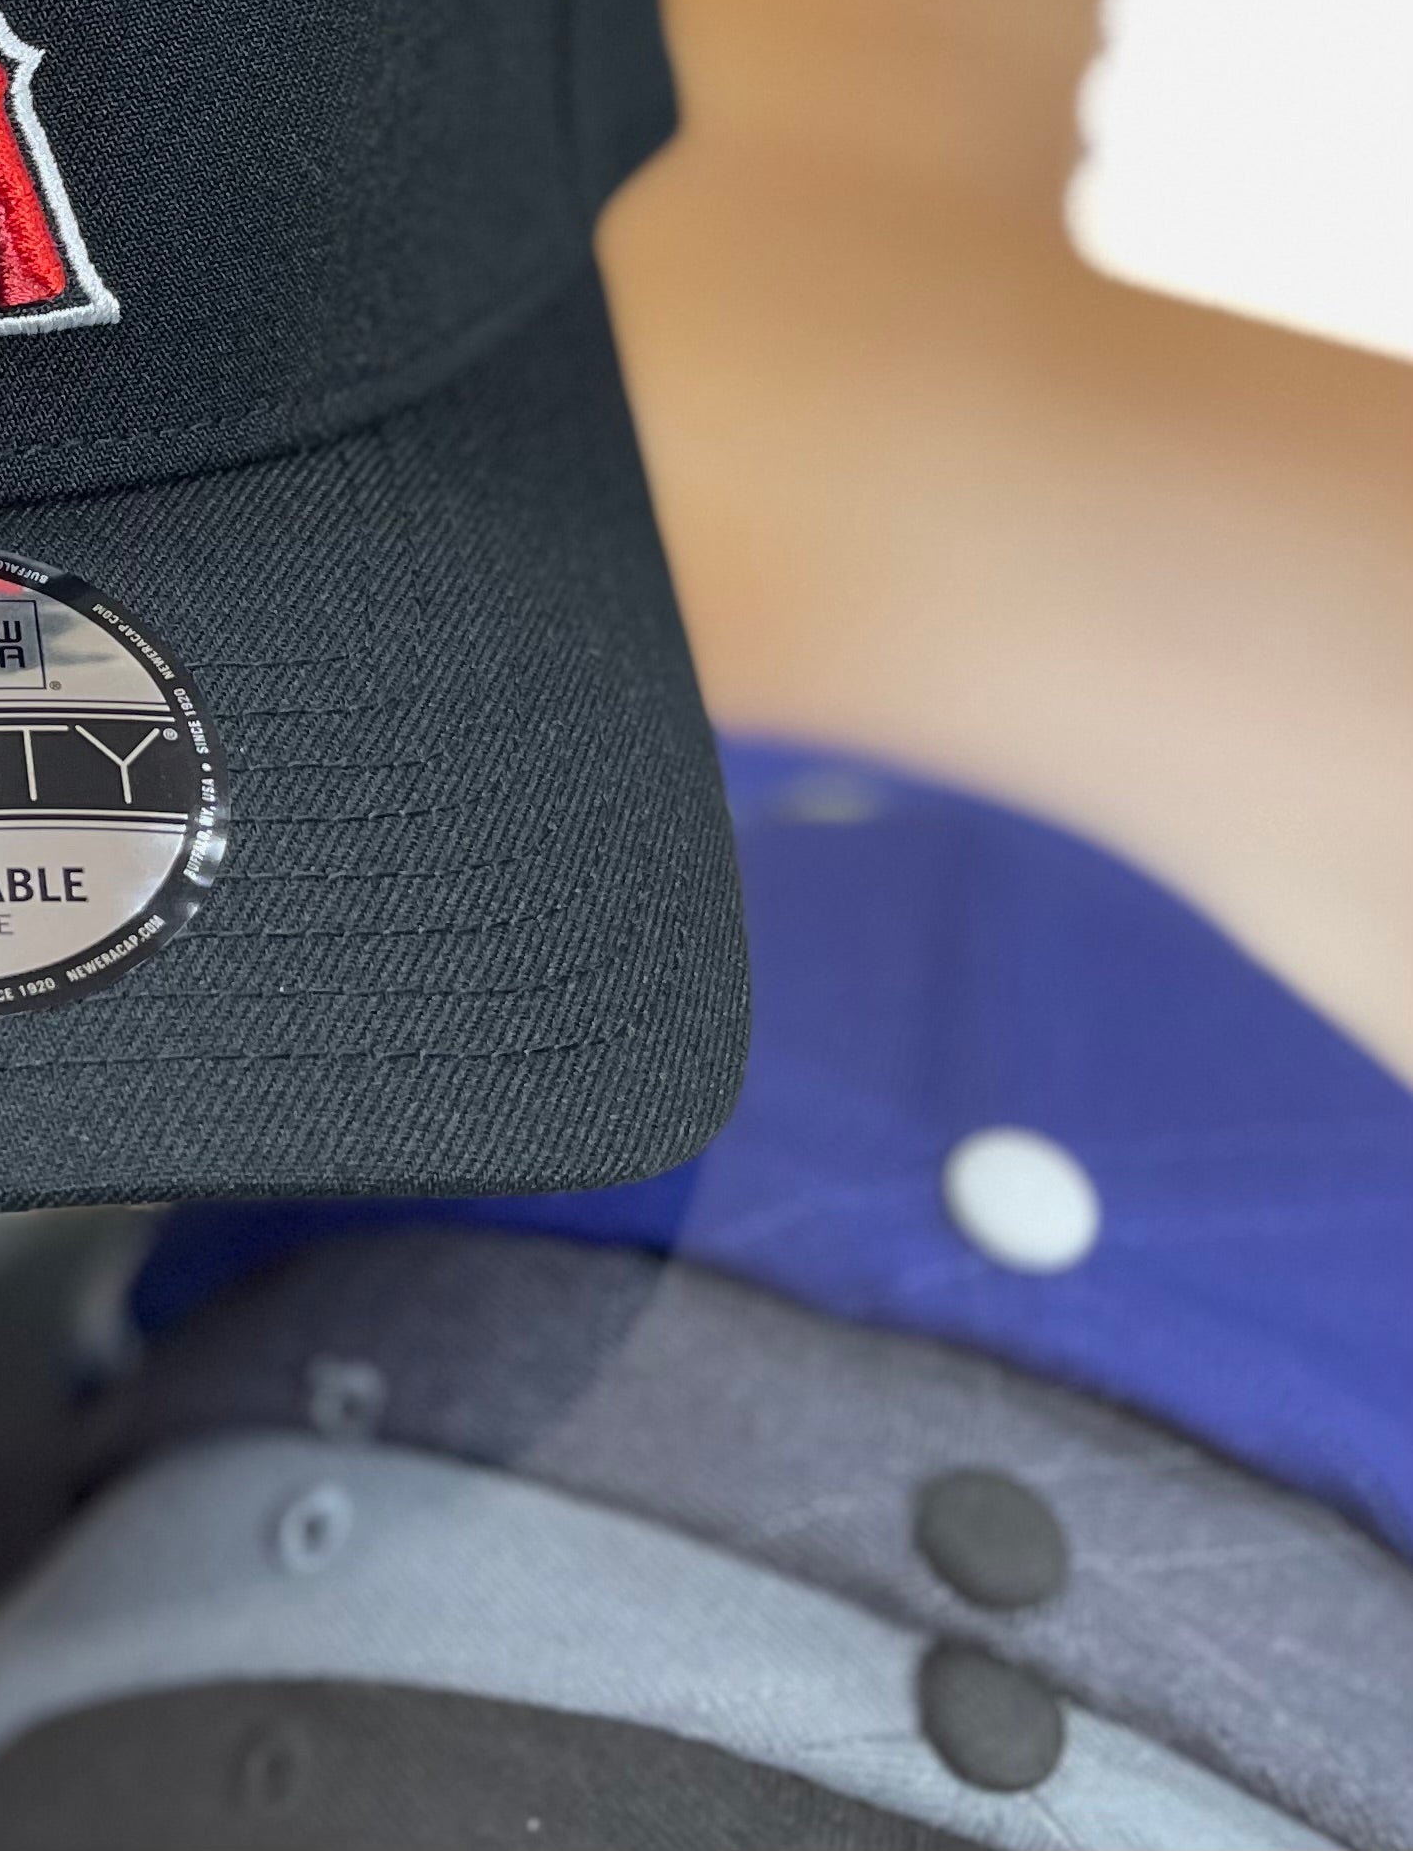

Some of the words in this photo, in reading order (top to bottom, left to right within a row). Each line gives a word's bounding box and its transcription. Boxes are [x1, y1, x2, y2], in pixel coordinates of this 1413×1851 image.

[91, 603, 175, 681] NEWERACAP.COM
[173, 687, 198, 717] 1920
[188, 720, 209, 755] SINCE
[201, 778, 216, 802] USA
[18, 976, 57, 999] 1920
[65, 912, 168, 984] NEWERACAP.COM
